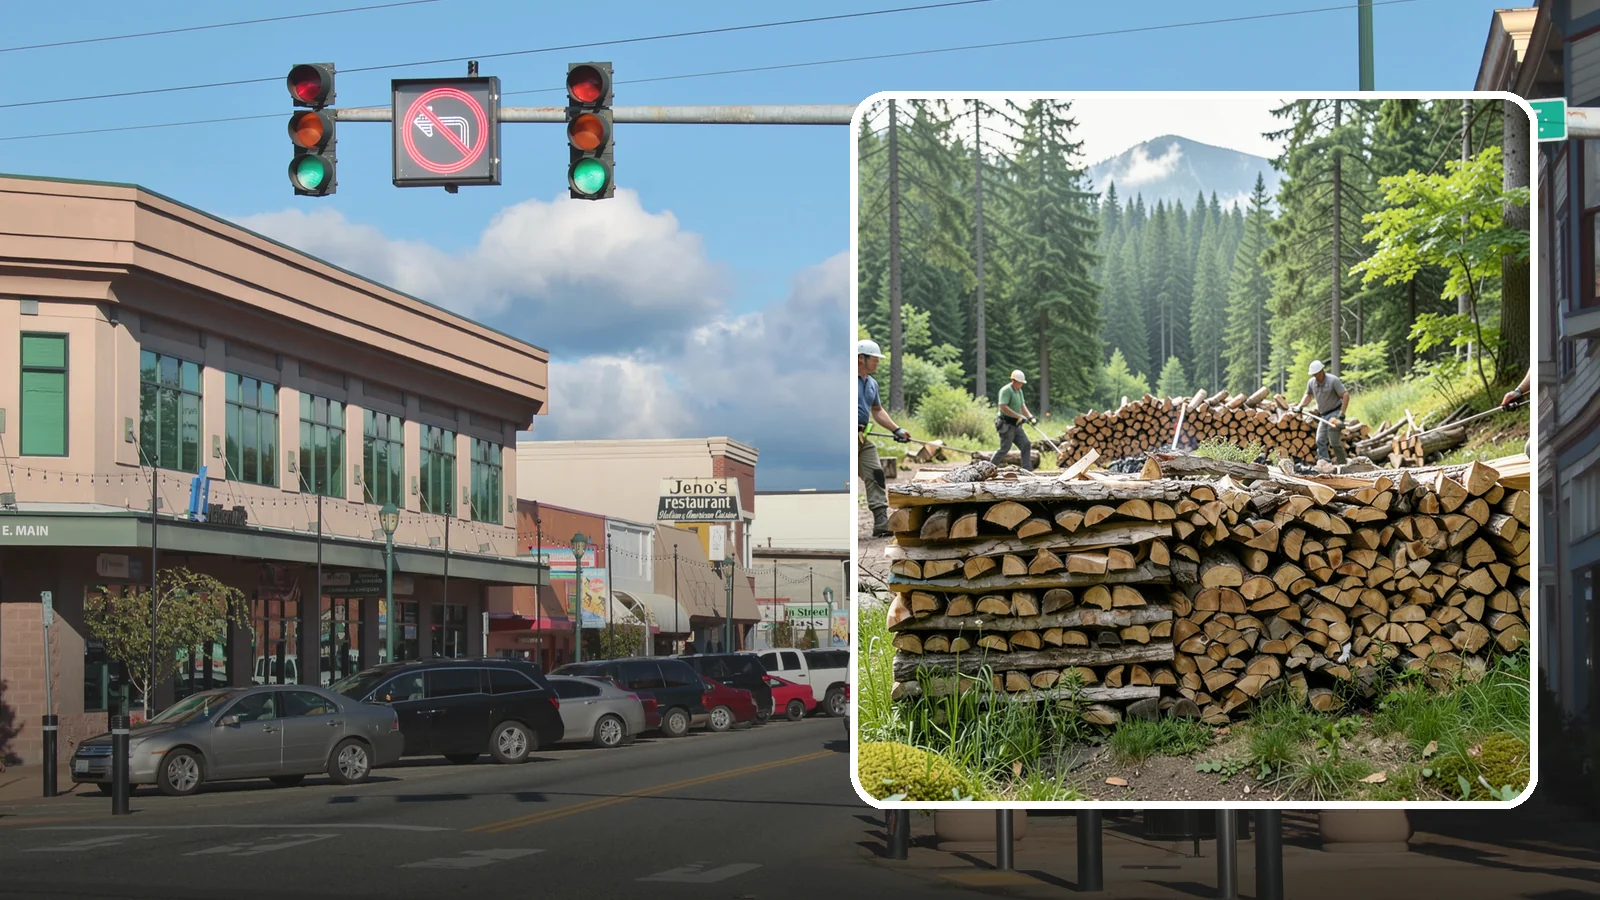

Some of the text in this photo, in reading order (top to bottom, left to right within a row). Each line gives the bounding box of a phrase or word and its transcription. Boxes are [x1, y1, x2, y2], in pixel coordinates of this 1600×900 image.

[669, 479, 728, 495] Jeno's
[665, 496, 731, 509] restaurant
[658, 509, 682, 520] Italian
[686, 509, 715, 519] American
[715, 509, 737, 519] Cuisine
[2, 525, 49, 536] E. MAIN
[797, 607, 828, 617] Street
